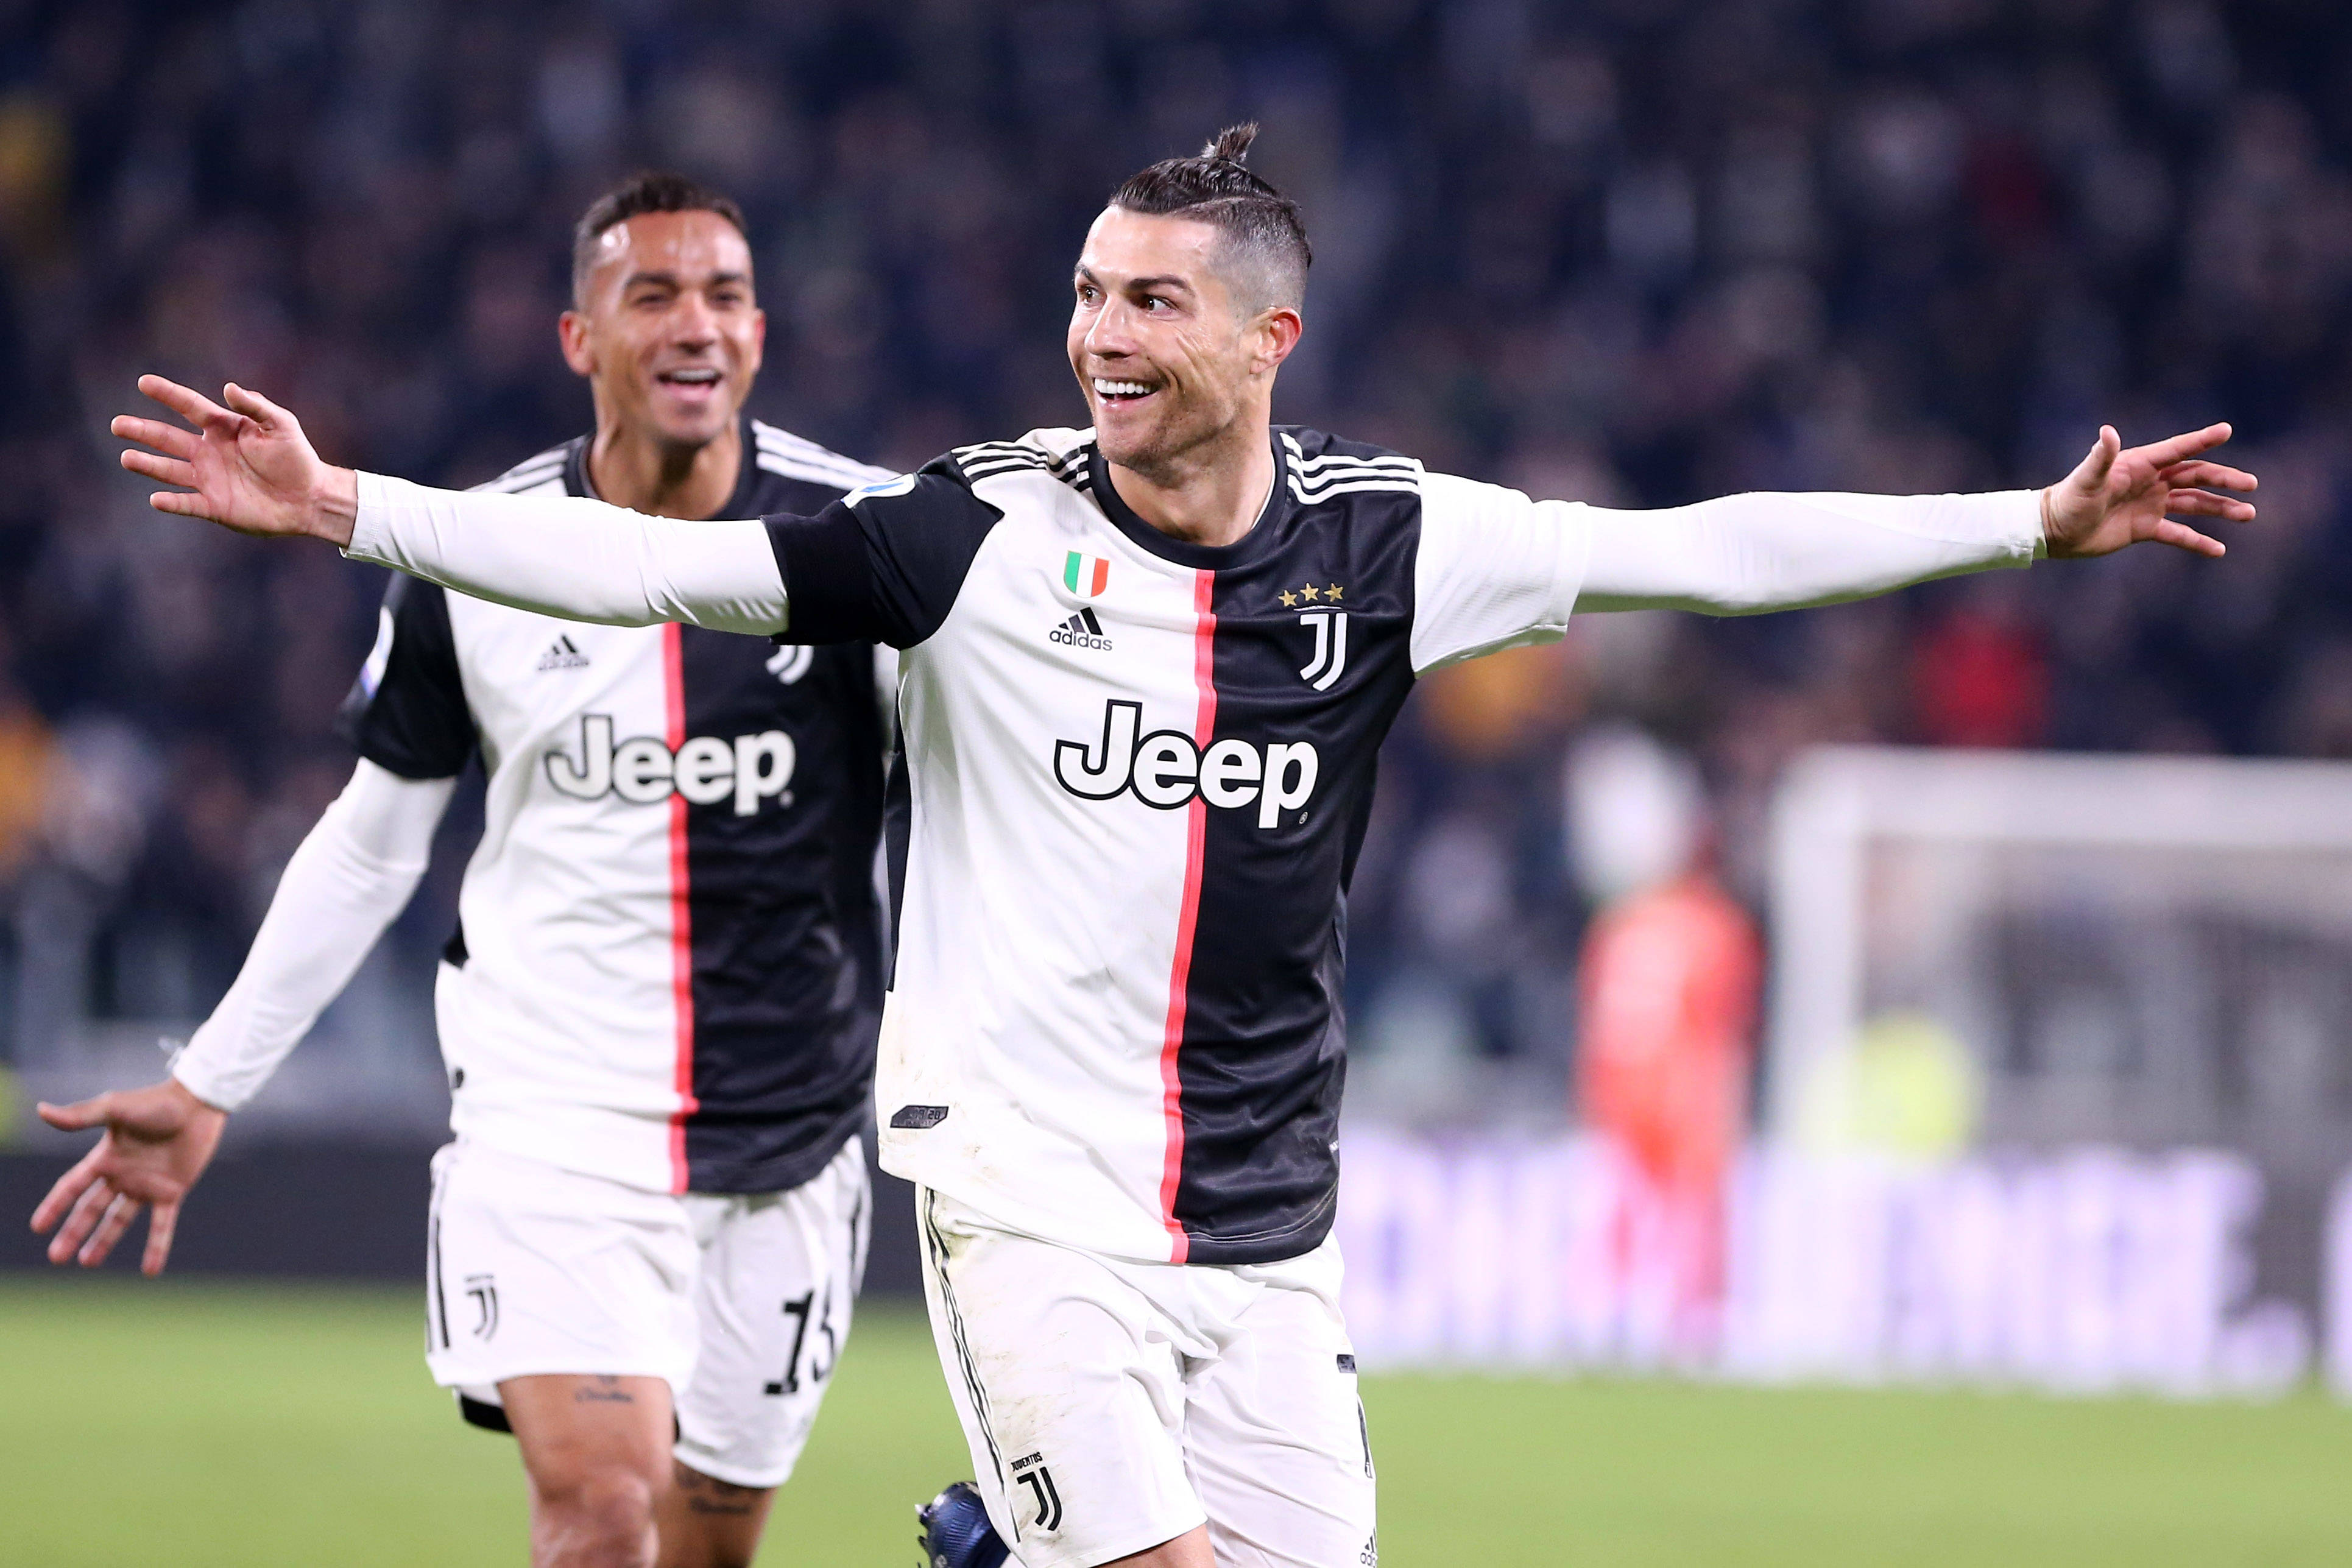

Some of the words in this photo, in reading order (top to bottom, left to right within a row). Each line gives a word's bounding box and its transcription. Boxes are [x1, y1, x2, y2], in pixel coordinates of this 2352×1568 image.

[1049, 630, 1112, 651] adidas
[544, 714, 796, 816] Jeep
[1054, 698, 1319, 829] Jeep
[1011, 1451, 1044, 1472] JUVENTUS
